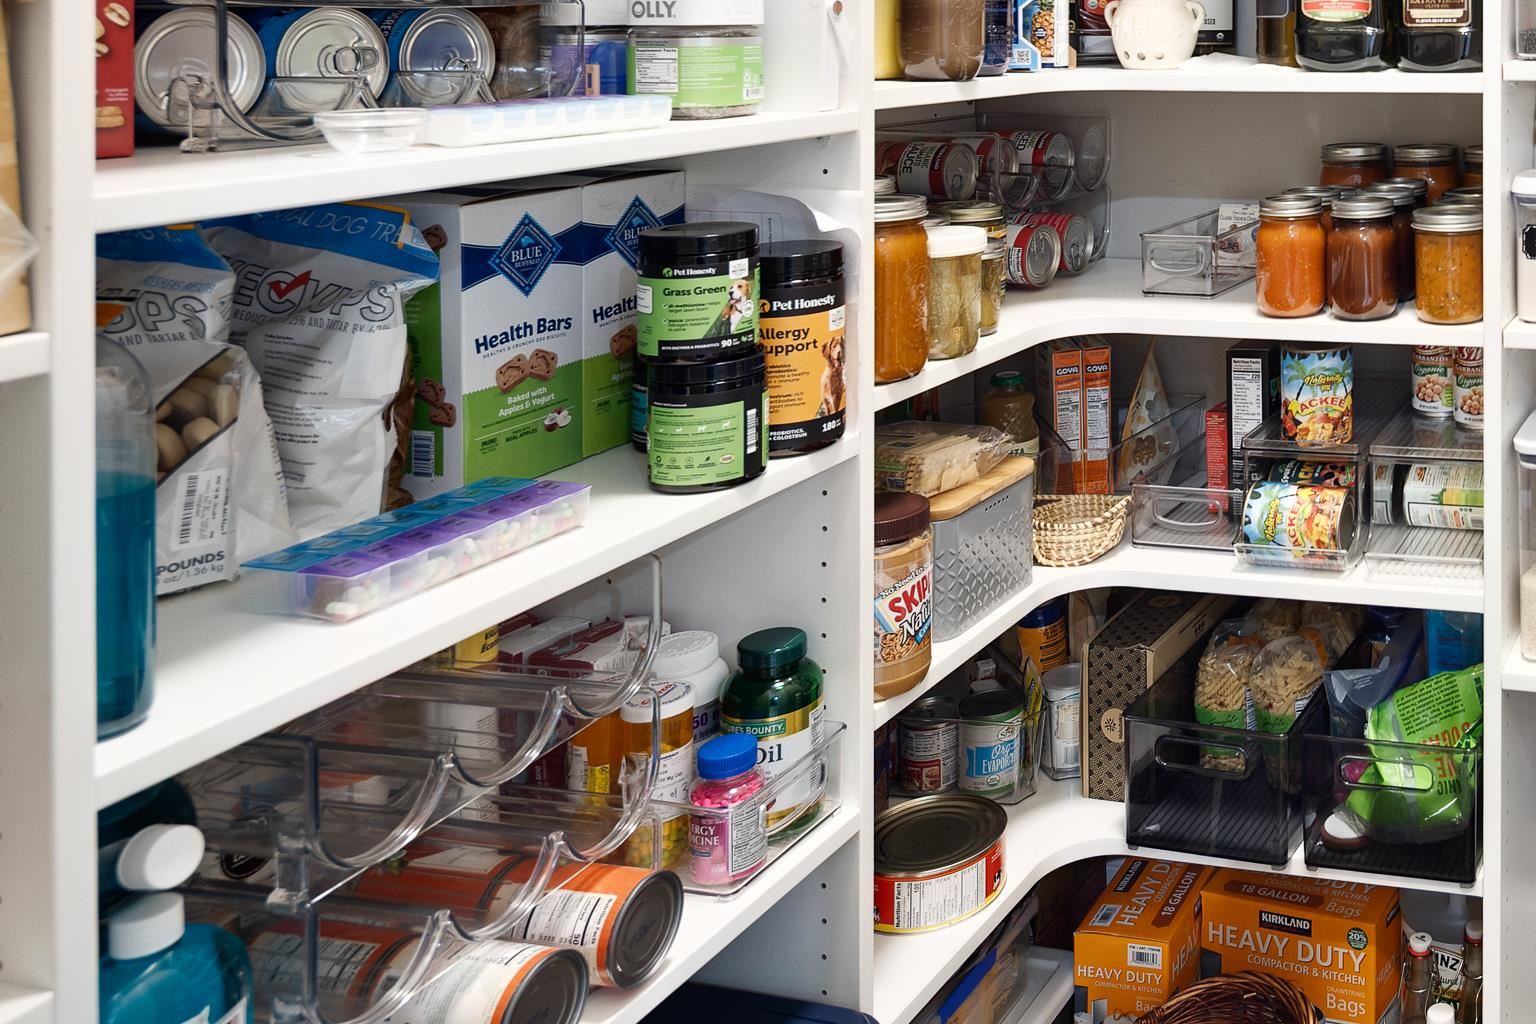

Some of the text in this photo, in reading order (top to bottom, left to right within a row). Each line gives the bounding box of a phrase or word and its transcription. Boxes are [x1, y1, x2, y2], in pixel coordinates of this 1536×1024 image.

[316, 214, 368, 234] DOG
[511, 244, 543, 262] BLUE
[674, 267, 717, 276] Pet Honesty
[663, 286, 727, 297] Grass Green
[772, 294, 836, 312] Pet Honesty
[475, 317, 573, 355] Health Bars
[721, 338, 732, 348] 90
[759, 327, 811, 341] Allergy
[1056, 366, 1079, 376] GOYA
[1086, 364, 1108, 373] GOYA
[1304, 373, 1343, 386] Naturally
[507, 386, 547, 404] Baked with
[499, 403, 525, 417] Apples
[531, 393, 556, 406] Yogurt
[1300, 397, 1346, 413] ACKEE
[822, 421, 836, 432] 180
[156, 550, 225, 576] POUNDS
[1116, 876, 1162, 926] HEAVY
[1161, 871, 1197, 916] 18 GALLON
[1241, 884, 1310, 904] 18 GALLON
[1332, 888, 1370, 902] KITCHEN
[1326, 901, 1362, 918] Bags
[1261, 912, 1310, 930] KIRKLAND
[1349, 932, 1366, 943] 20%
[1207, 921, 1366, 973] HEAVY DUTY
[1077, 965, 1162, 986] HEAVY DUTY
[1247, 954, 1309, 975] COMPACTOR
[1322, 970, 1366, 986] KITCHEN
[1095, 980, 1132, 991] COMPACTOR
[1137, 985, 1163, 994] KITCHEN
[1327, 985, 1366, 998] DRAWSTRING
[1326, 994, 1366, 1017] Bags
